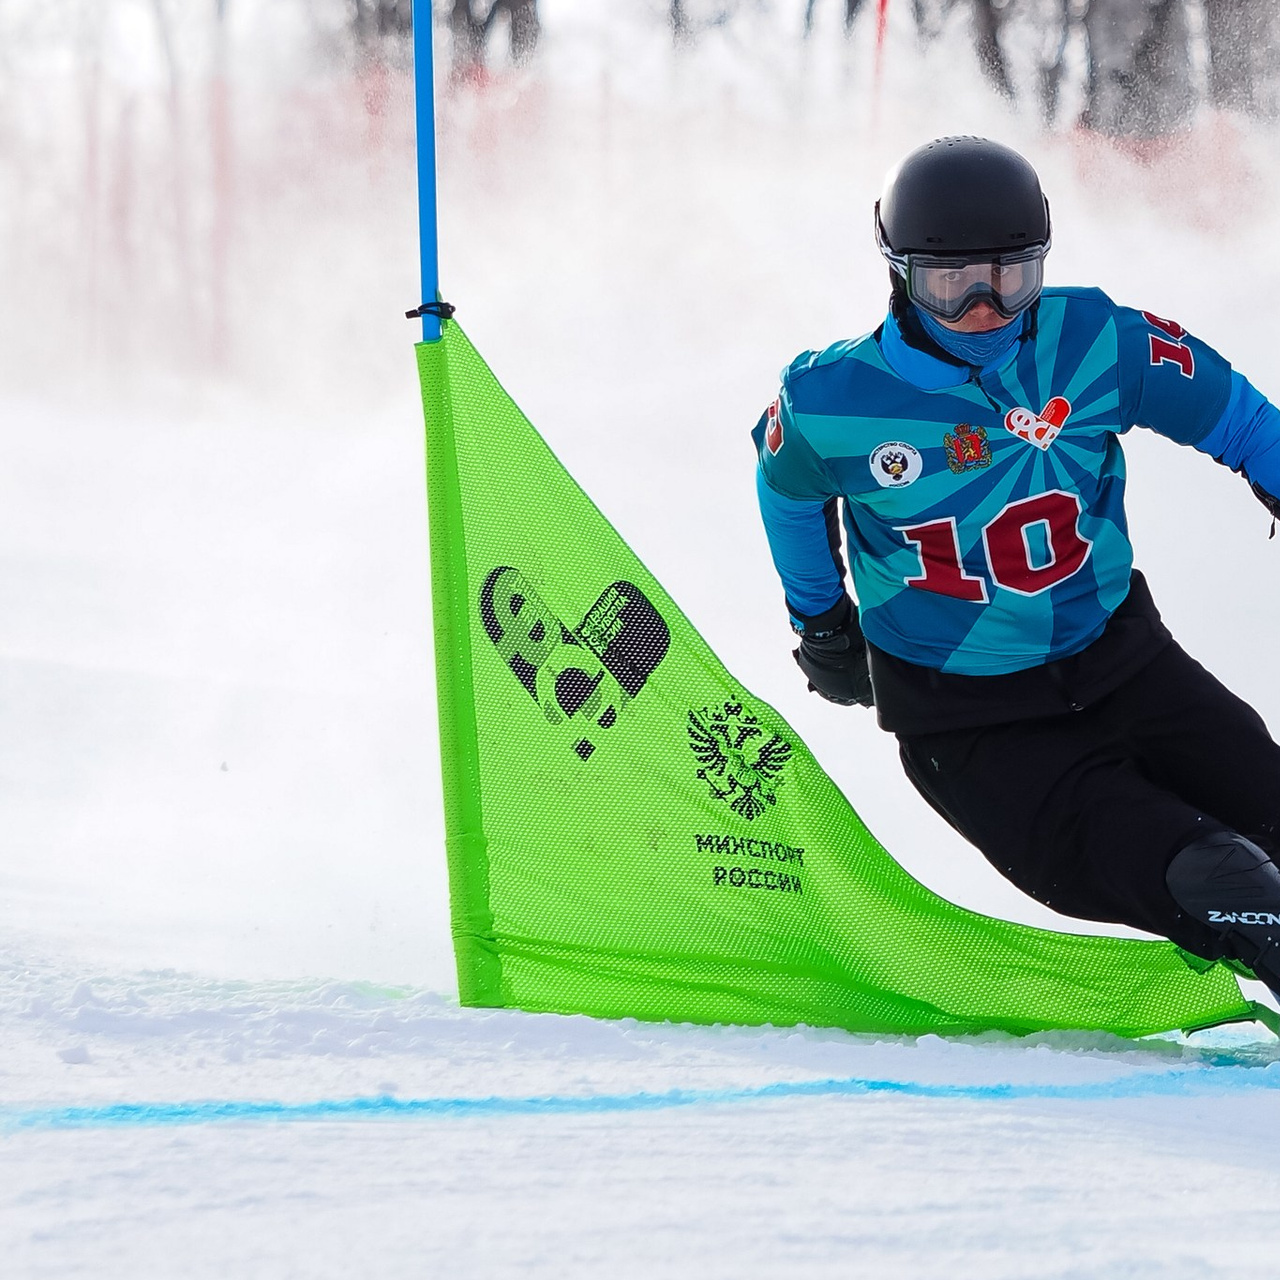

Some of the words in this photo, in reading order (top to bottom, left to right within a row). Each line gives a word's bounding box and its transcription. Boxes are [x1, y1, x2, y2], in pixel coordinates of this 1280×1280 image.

[893, 489, 1093, 603] 10
[694, 834, 805, 866] МИНСПОРТ
[713, 866, 803, 895] РОССИИ
